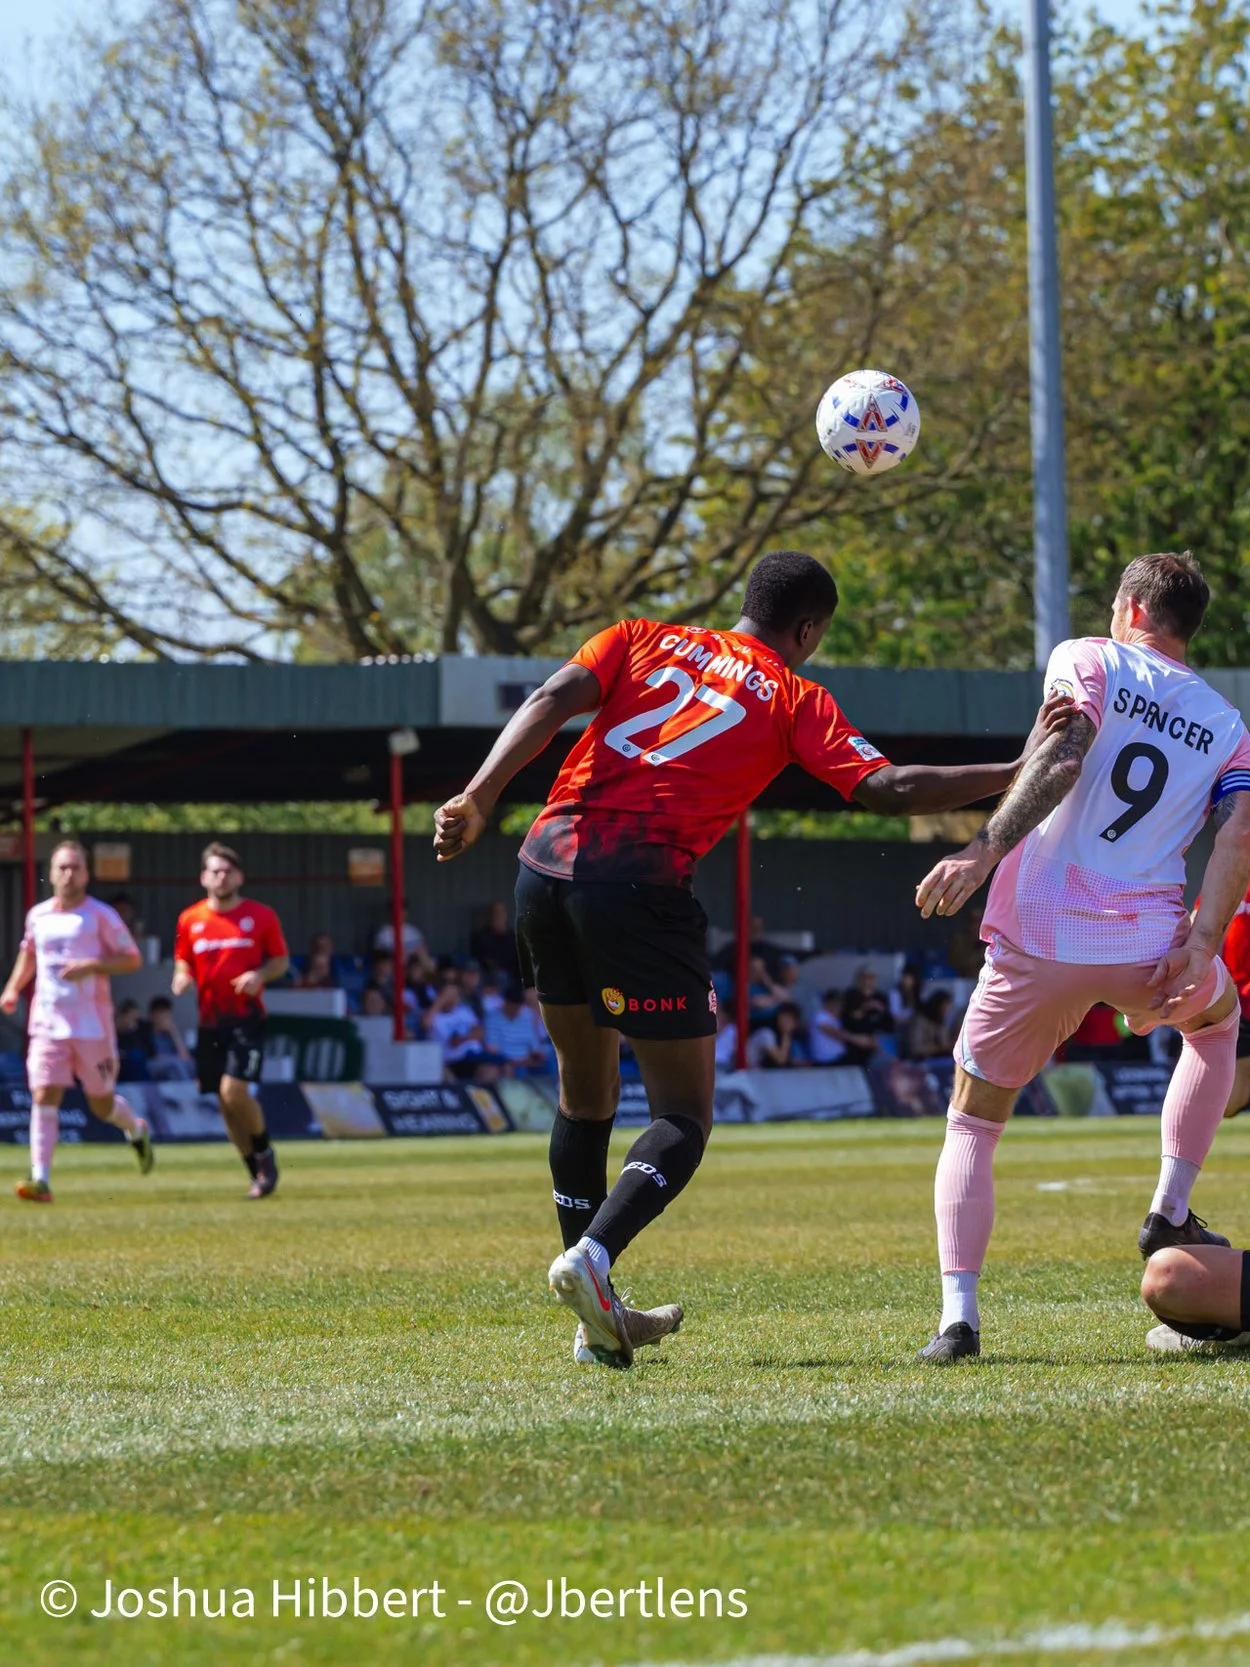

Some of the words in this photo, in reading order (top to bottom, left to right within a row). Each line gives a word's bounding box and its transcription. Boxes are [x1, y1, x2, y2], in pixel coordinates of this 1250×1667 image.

[660, 634, 779, 701] CUMMINGS
[604, 666, 747, 766] 27
[1099, 742, 1169, 843] 9
[628, 997, 687, 1012] BONK
[621, 1161, 668, 1188] EDS
